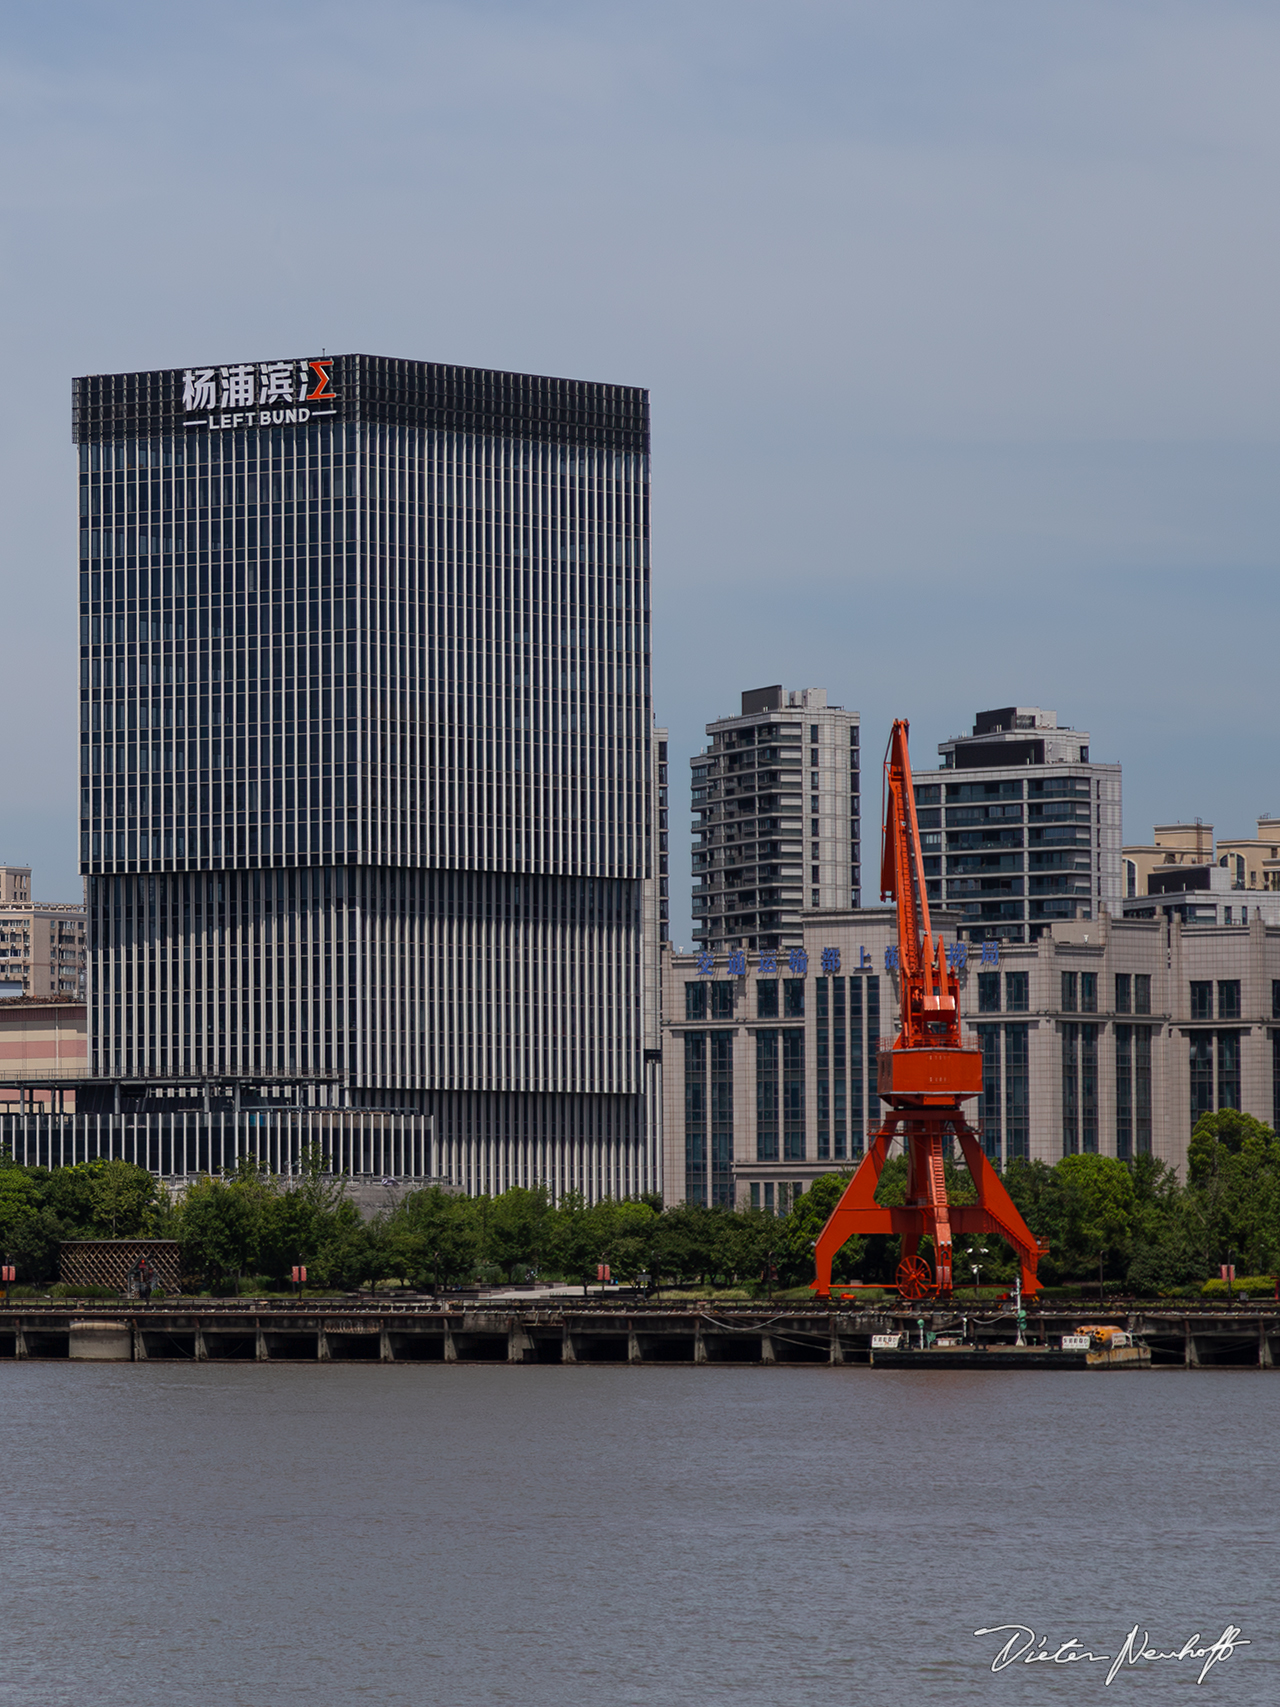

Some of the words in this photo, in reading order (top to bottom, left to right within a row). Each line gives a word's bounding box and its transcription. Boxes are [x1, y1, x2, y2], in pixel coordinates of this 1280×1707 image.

[182, 360, 336, 411] 杨浦滨江
[209, 412, 256, 430] LEFT
[260, 408, 311, 426] BUND
[696, 941, 999, 976] 交通运输部上海捞局
